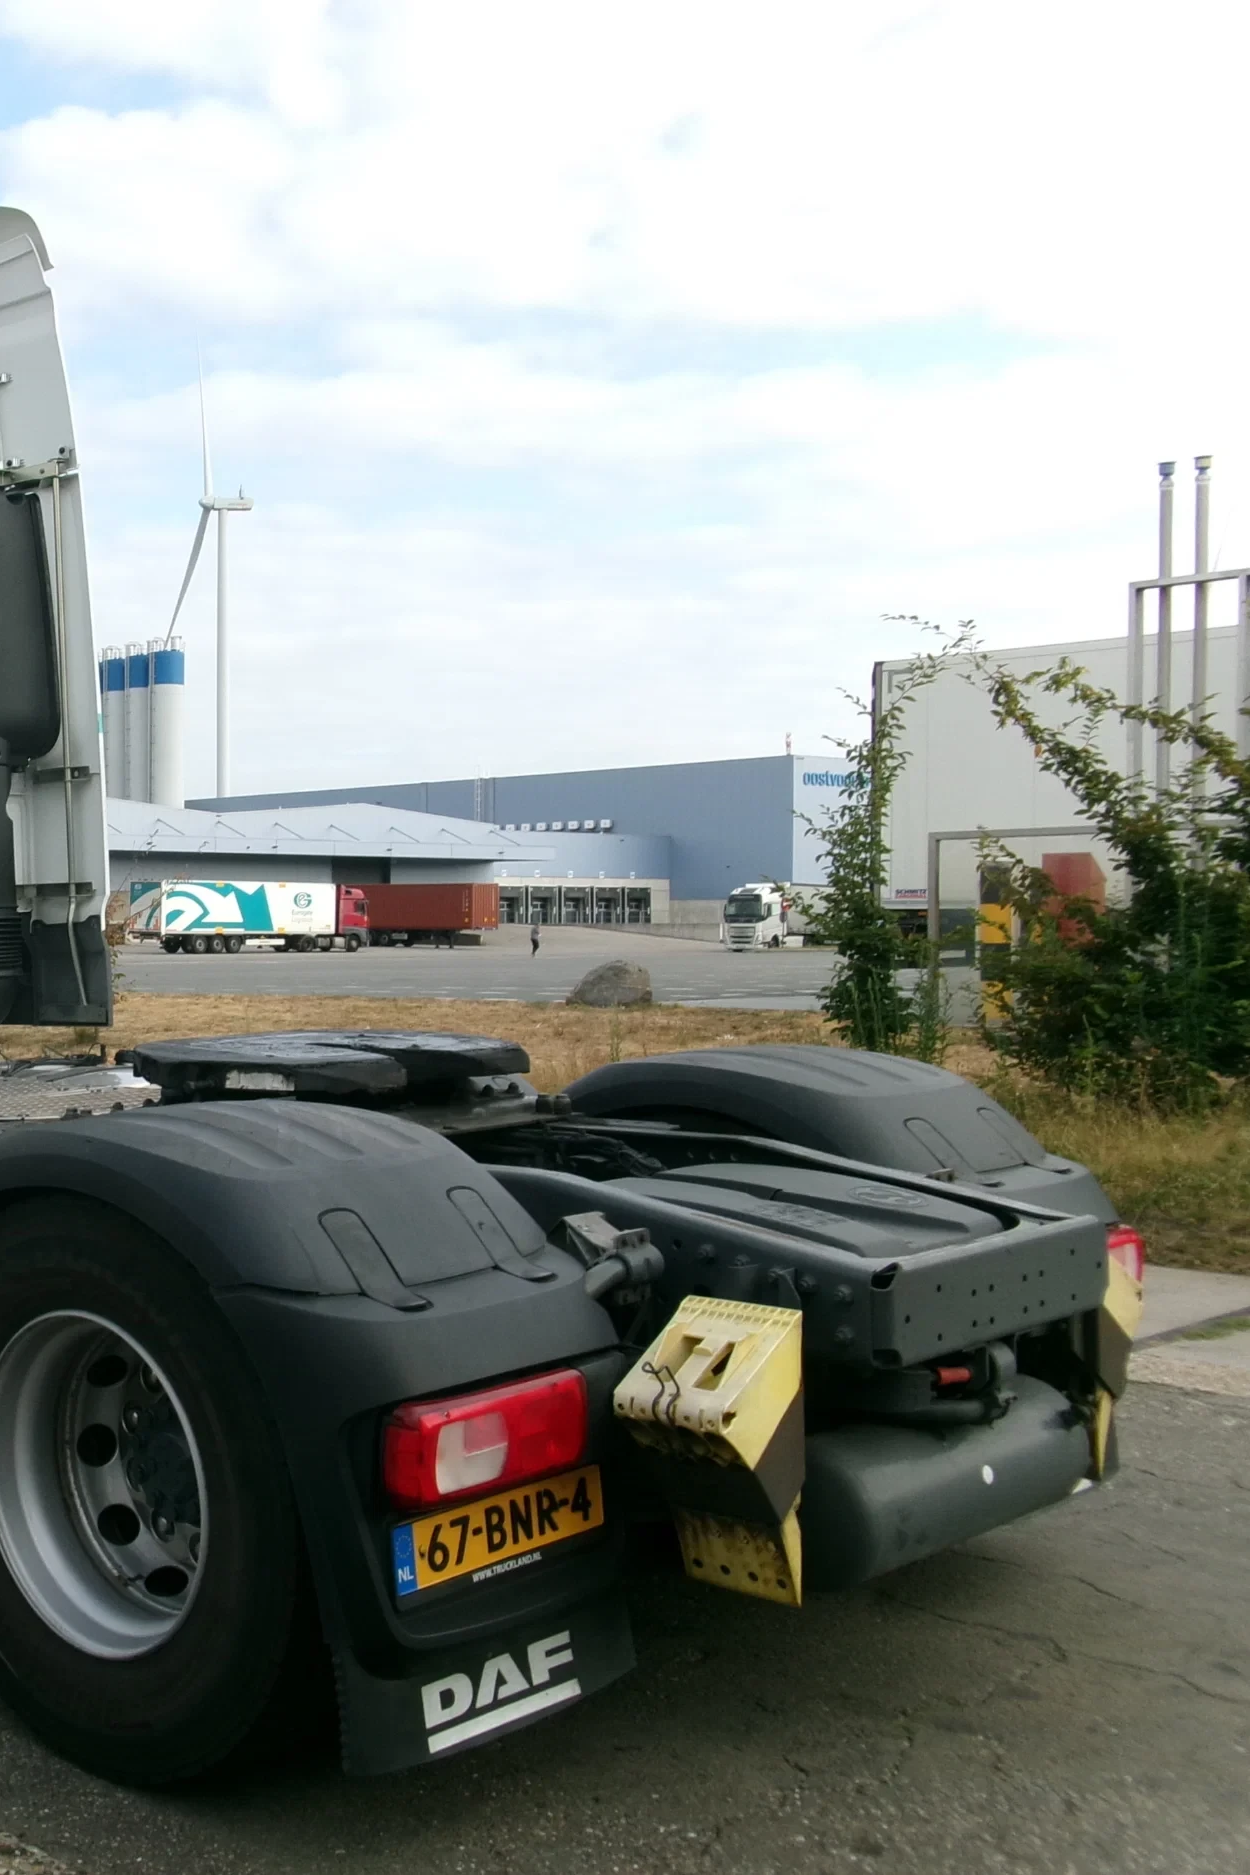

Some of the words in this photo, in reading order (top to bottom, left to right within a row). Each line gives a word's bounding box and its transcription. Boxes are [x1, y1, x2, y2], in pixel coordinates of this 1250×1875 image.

[427, 1477, 592, 1573] 67-BNR-4
[397, 1566, 414, 1584] NL
[471, 1551, 542, 1583] WWW.TRUCKLAND.NL
[421, 1630, 574, 1729] DAF
